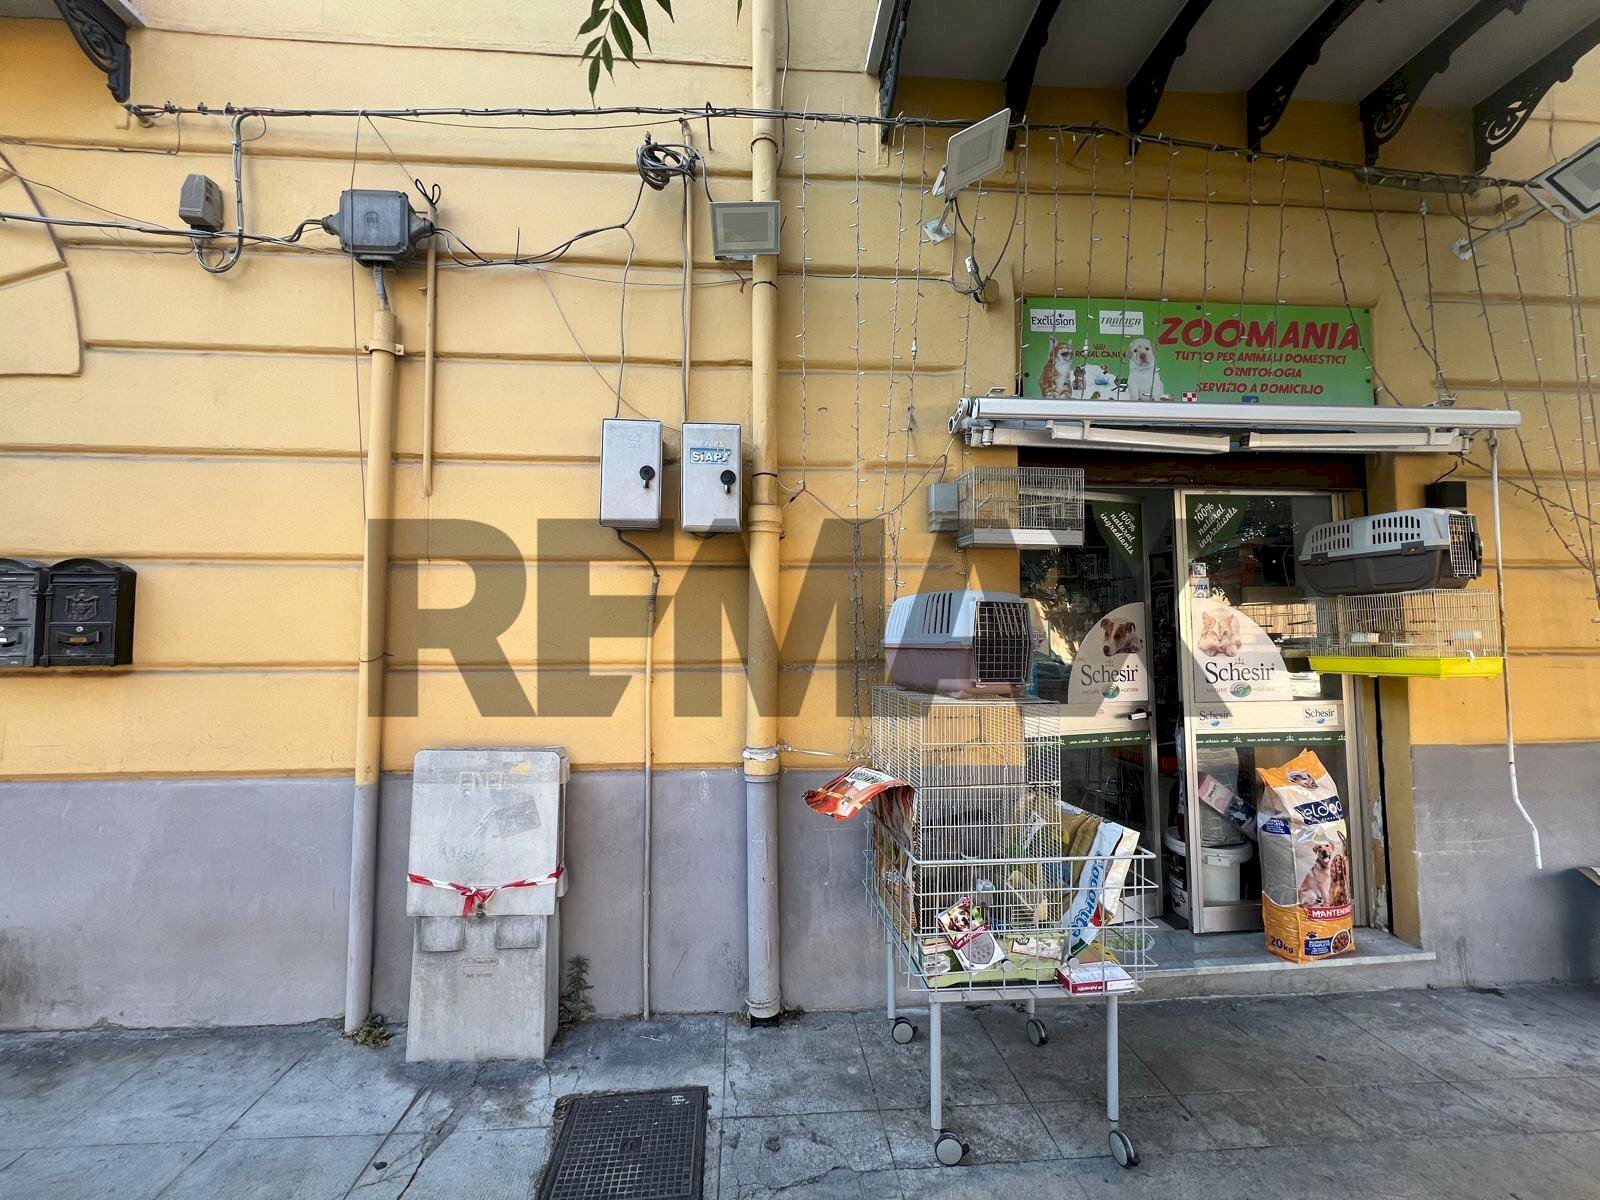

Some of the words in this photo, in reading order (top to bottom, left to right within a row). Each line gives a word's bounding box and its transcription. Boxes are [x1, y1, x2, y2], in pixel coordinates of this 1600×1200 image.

[1031, 315, 1075, 327] Exclusion
[1157, 317, 1361, 350] ZOOMANIA
[1075, 350, 1099, 358] ROYAL
[1174, 351, 1214, 361] TUTTO
[1216, 351, 1235, 362] PER
[1237, 352, 1284, 363] ANIMALI
[1285, 353, 1347, 364] DOMESTICI
[1223, 366, 1303, 378] ORNITOLOGIA
[1196, 382, 1247, 393] SERVIZIO
[1250, 383, 1258, 393] A
[1260, 384, 1324, 394] DOMICILIO
[1118, 511, 1135, 532] 100%
[1194, 503, 1214, 524] 100%
[1199, 504, 1225, 536] natural
[1100, 512, 1133, 556] ingredients
[1110, 513, 1135, 543] natural
[1197, 507, 1238, 548] ingredients
[1081, 664, 1138, 686] Schesir
[1205, 661, 1275, 684] Schesir
[1199, 710, 1231, 721] Schesir
[1304, 708, 1335, 719] Schesir
